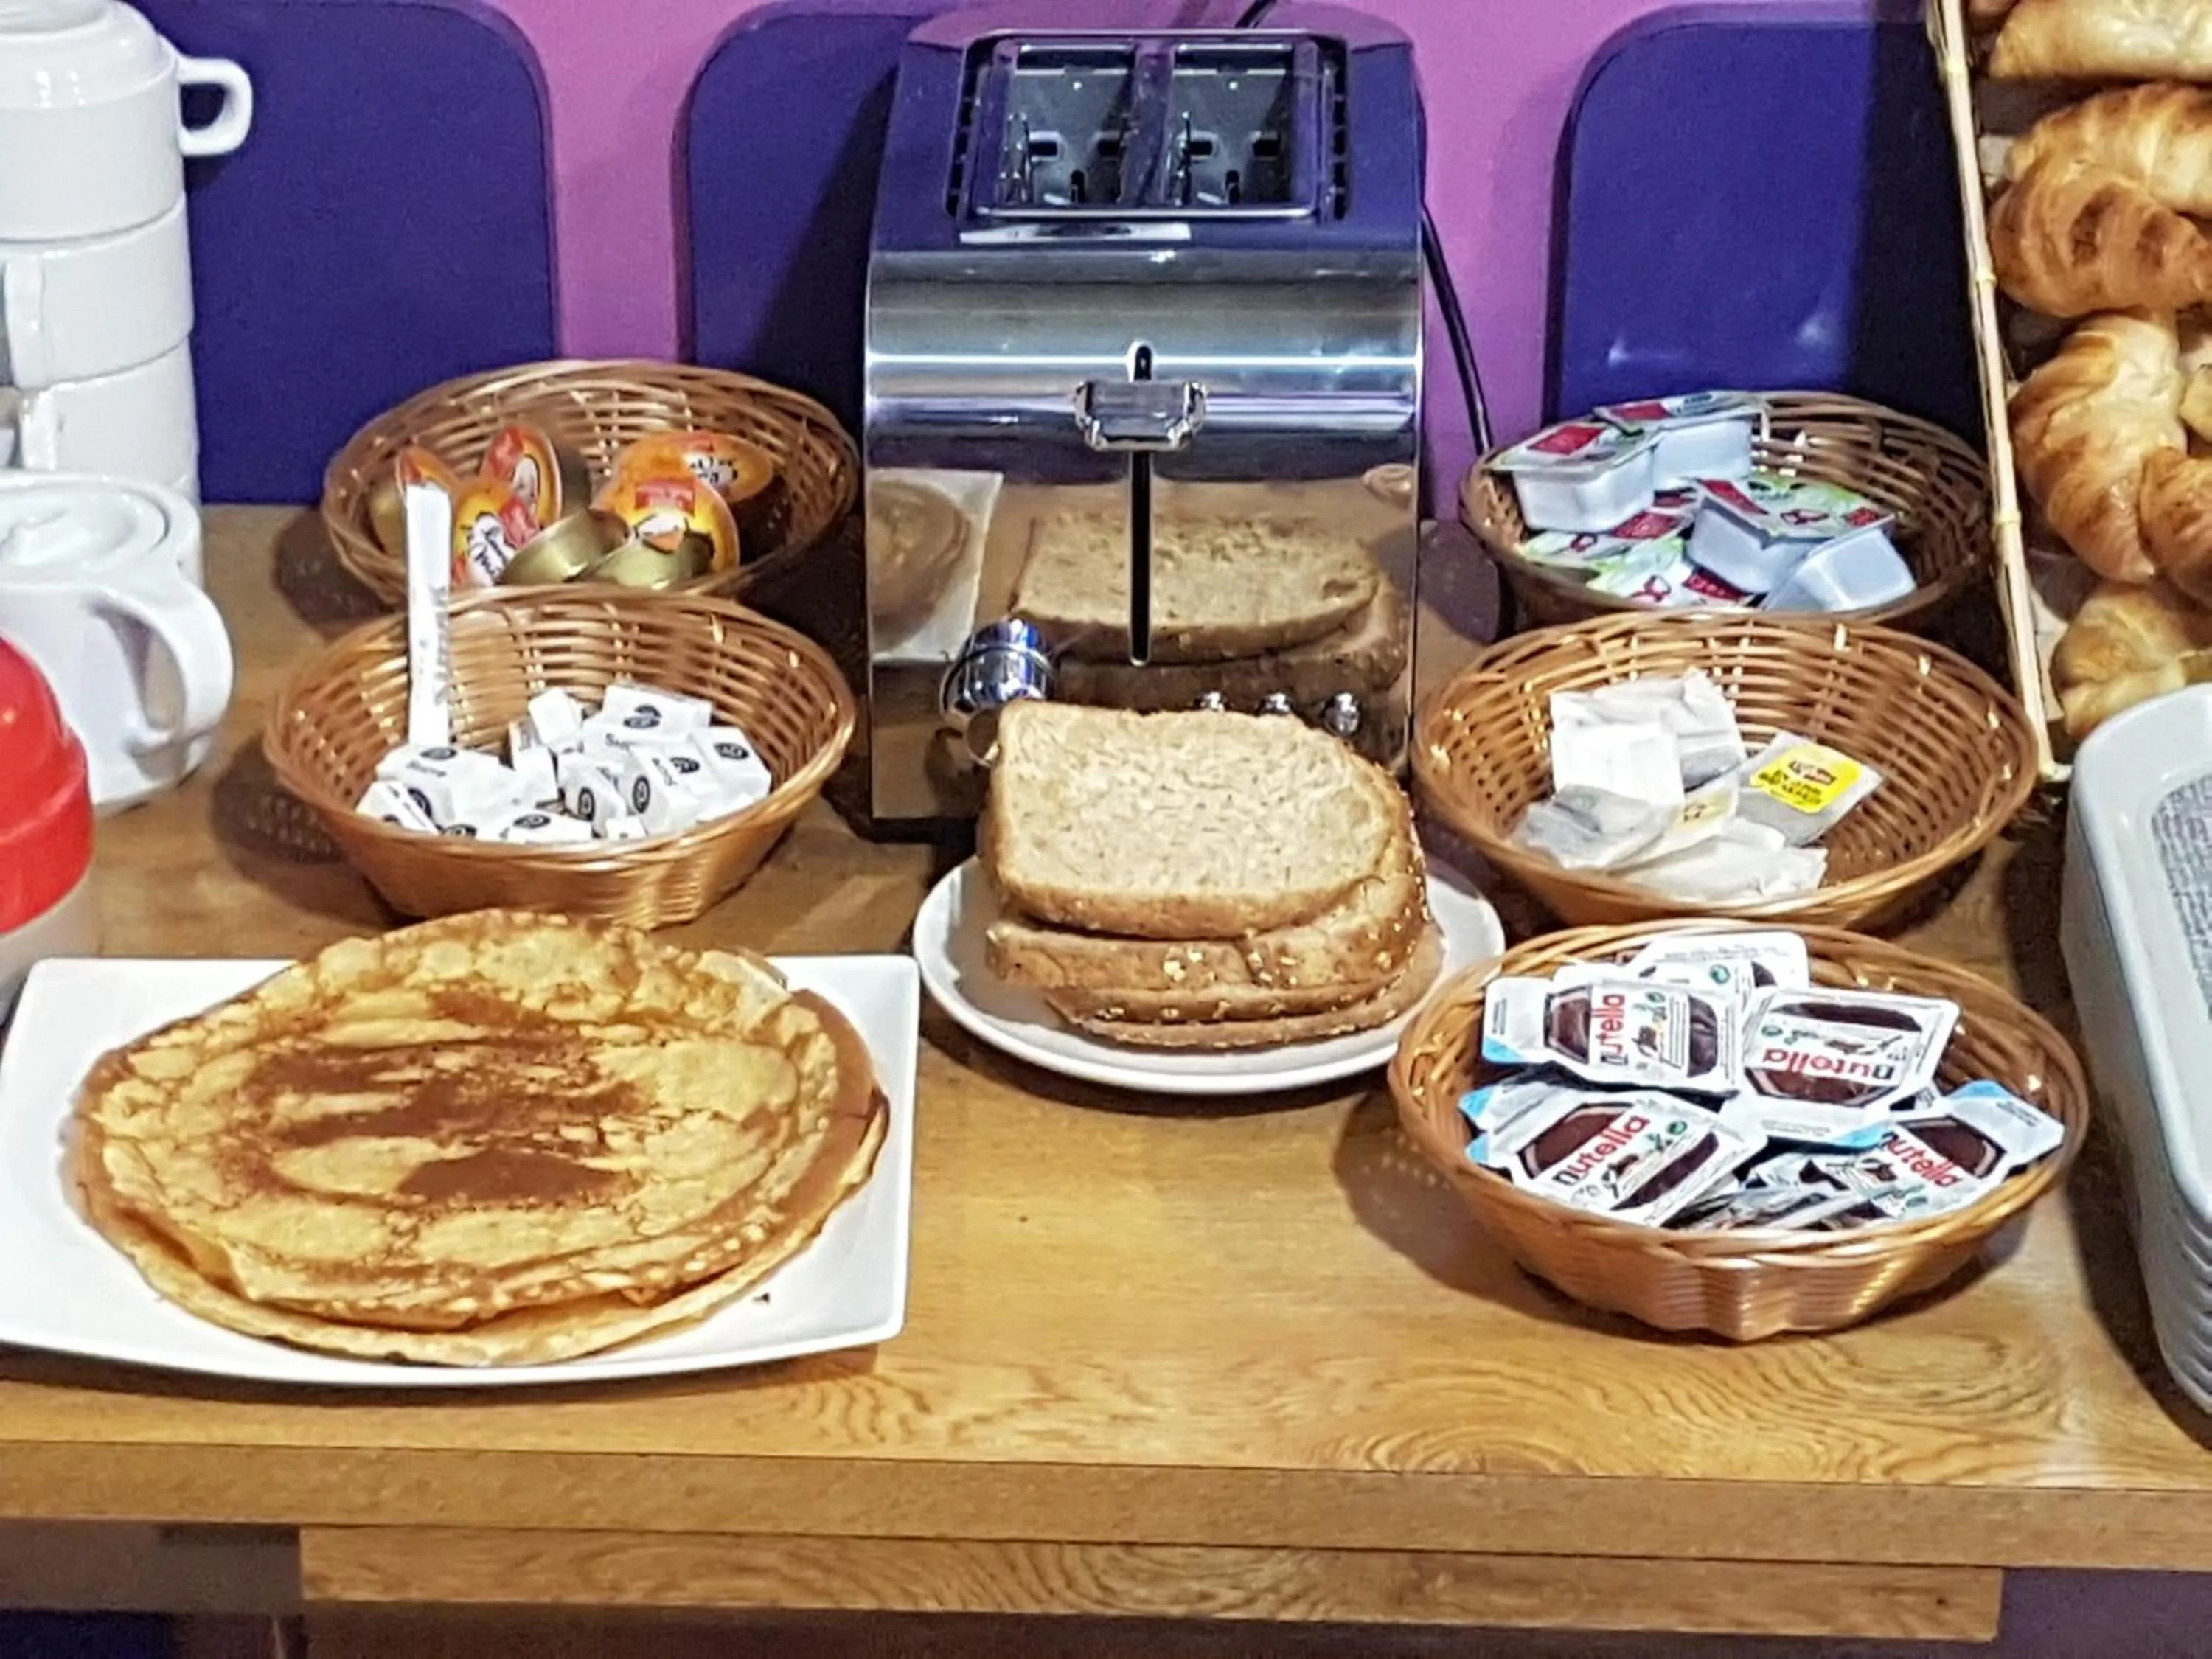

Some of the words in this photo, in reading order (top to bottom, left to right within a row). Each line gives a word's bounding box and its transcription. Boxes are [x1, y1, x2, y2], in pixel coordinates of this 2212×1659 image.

[1591, 994, 1629, 1066] nutella
[1551, 1115, 1651, 1186] nutella
[1881, 1130, 1964, 1188] nutella
